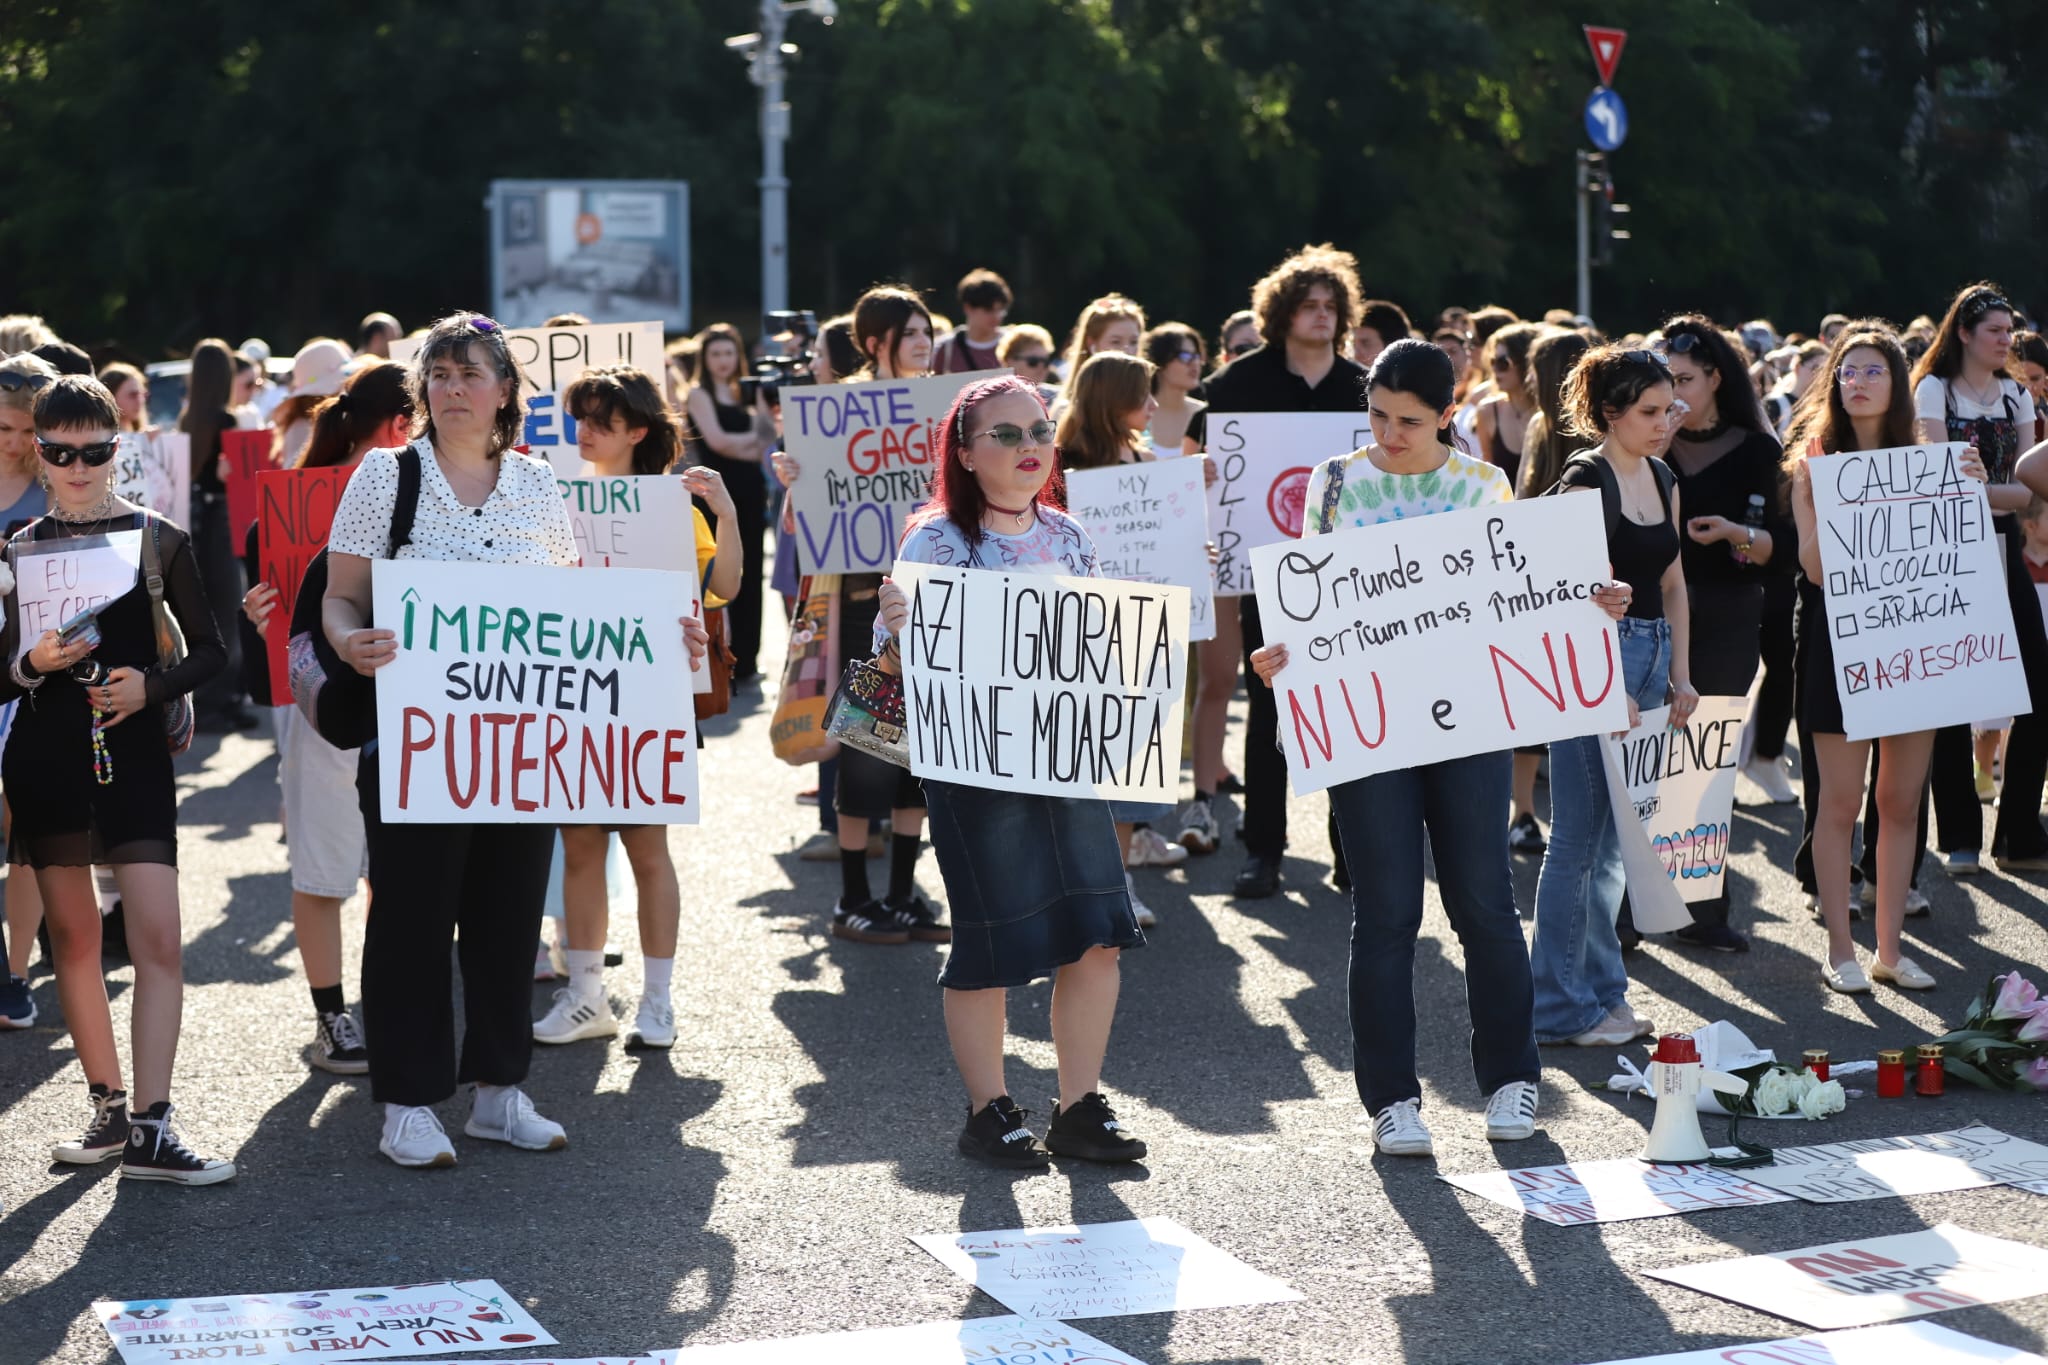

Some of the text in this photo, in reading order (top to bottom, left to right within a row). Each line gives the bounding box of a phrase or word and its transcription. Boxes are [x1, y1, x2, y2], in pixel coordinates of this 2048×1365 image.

[791, 387, 915, 438] TOATE
[847, 417, 935, 475] GAGI
[824, 468, 935, 506] ÎMPOTRIV
[1118, 474, 1149, 496] MY
[1837, 447, 1966, 504] CAUZA
[1081, 499, 1163, 520] FAVORITE
[1115, 519, 1162, 535] SEASON
[1101, 558, 1151, 576] FALL
[1135, 541, 1156, 551] THE
[46, 559, 78, 592] EU
[1277, 517, 1527, 622] Oriunde aș fi,
[1851, 552, 1977, 595] ALCOOLUL
[20, 600, 49, 636] TE
[401, 587, 653, 664] ÎMPREUNĂ
[911, 573, 1171, 688] AZI IGNORATĂ
[1308, 619, 1409, 661] oricum
[1414, 600, 1472, 634] m-aș
[1874, 633, 2016, 690] AGRESORUL
[445, 660, 618, 717] SUNTEM
[1287, 627, 1614, 769] NU e NU
[912, 674, 1164, 788] MAINE MOARTĂ
[399, 707, 686, 812] PUTERNICE
[1621, 719, 1742, 789] VIOLENCE
[1786, 1249, 1907, 1277] NU
[379, 1300, 464, 1317] CADE
[126, 1316, 456, 1345] VREM SOLIDARITATE
[287, 1334, 391, 1353] VREM
[413, 1327, 484, 1346] NU
